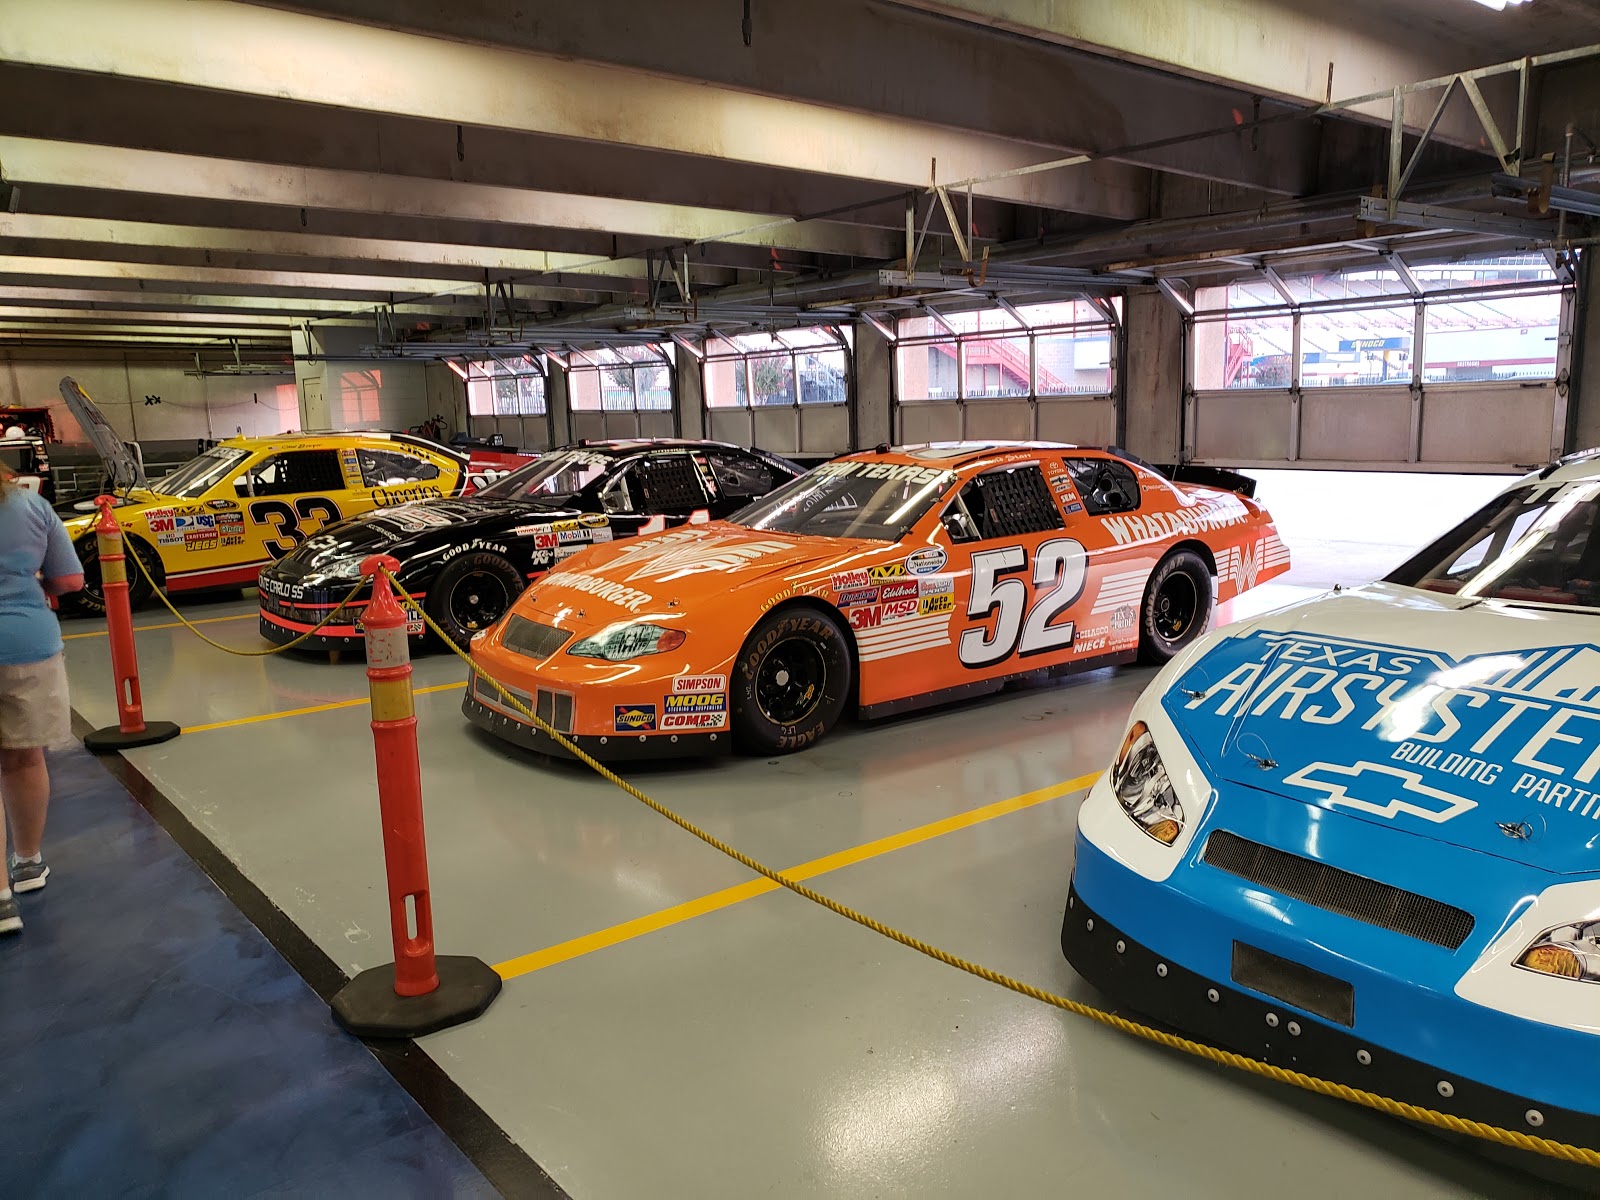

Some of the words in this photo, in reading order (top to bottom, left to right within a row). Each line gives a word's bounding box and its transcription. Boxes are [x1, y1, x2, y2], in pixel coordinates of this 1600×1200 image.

[1351, 340, 1385, 349] SNOCO
[856, 463, 942, 485] TEXAS
[371, 484, 443, 507] Cheerios
[144, 508, 174, 519] Holley
[149, 518, 175, 533] 3M
[195, 514, 214, 528] USG
[186, 532, 218, 540] CRAFTSMAN
[535, 533, 558, 548] 3M
[560, 531, 581, 540] Mobil
[187, 540, 218, 552] JEGS
[832, 571, 868, 586] Holley
[269, 580, 290, 598] CARLO
[291, 585, 305, 600] SS
[882, 586, 918, 600] Edelbrock
[928, 601, 952, 613] Meter
[931, 595, 948, 605] Auto
[957, 537, 1089, 669] 52
[884, 601, 918, 616] MSD
[851, 605, 882, 630] 3M
[1079, 626, 1109, 640] CHASCO
[1073, 638, 1107, 654] NIECE
[1264, 638, 1422, 675] TEXAS
[676, 677, 722, 691] SIMPSON
[666, 693, 725, 707] MOOG
[616, 714, 655, 724] SUNOCO
[663, 714, 711, 727] COMP
[776, 720, 826, 750] EAGLE
[1390, 740, 1505, 786] BUILDING
